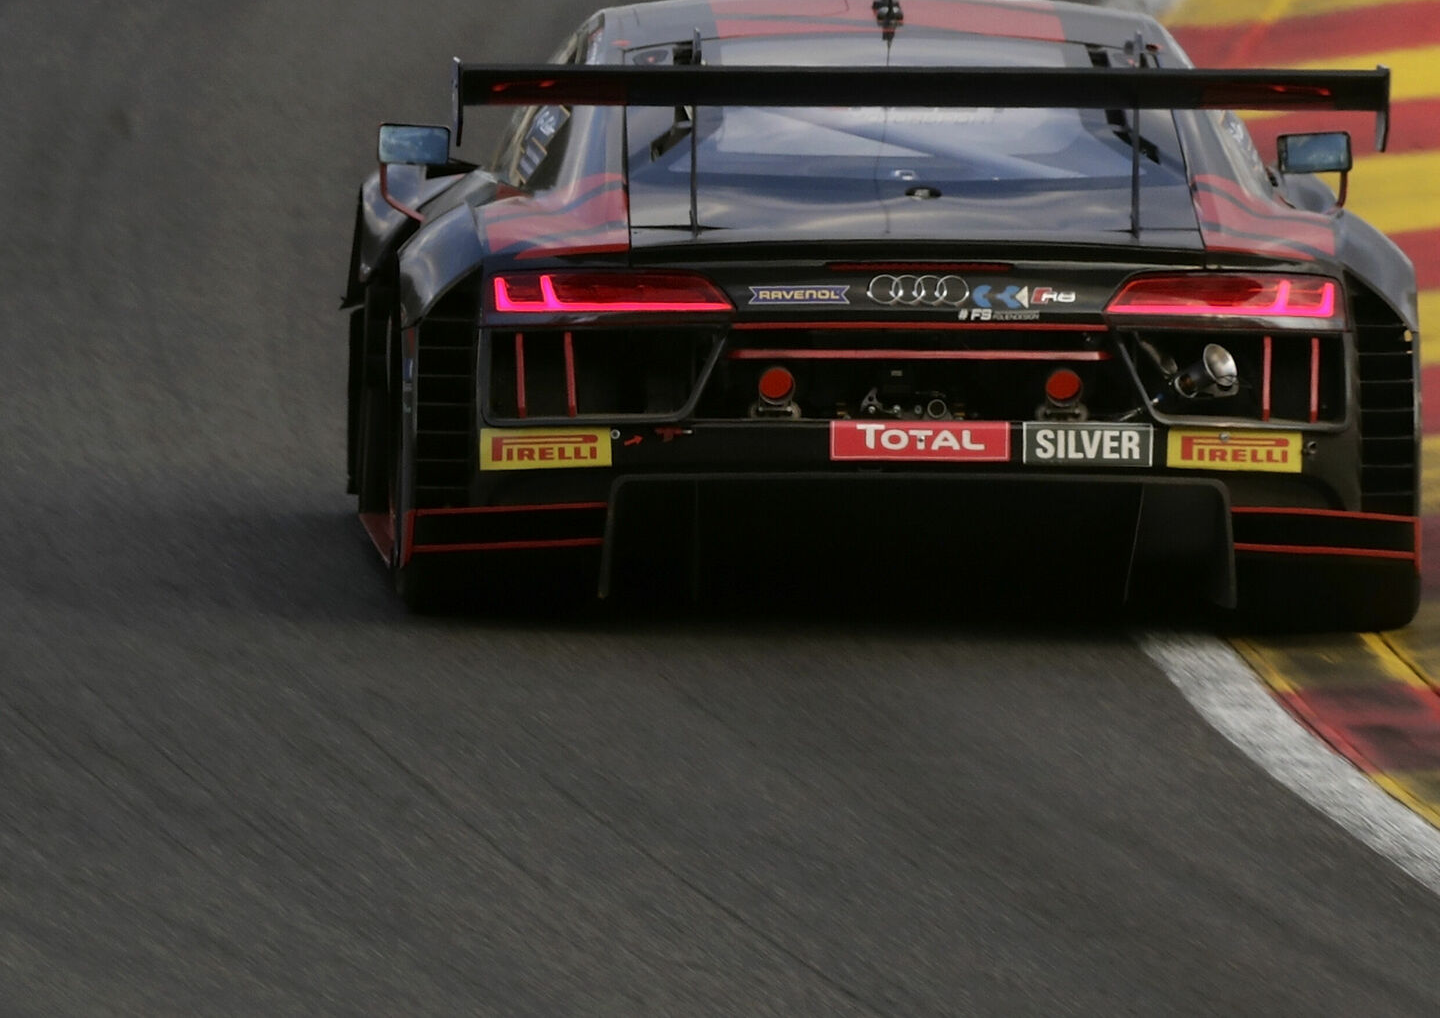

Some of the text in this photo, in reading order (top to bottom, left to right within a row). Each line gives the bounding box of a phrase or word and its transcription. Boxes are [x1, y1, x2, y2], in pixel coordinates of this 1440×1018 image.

[759, 290, 840, 299] RAVENOL
[491, 434, 598, 462] PIRELLI
[856, 423, 986, 451] TOTAL
[1035, 429, 1141, 460] SILVER
[1181, 435, 1290, 464] PIRELLI
